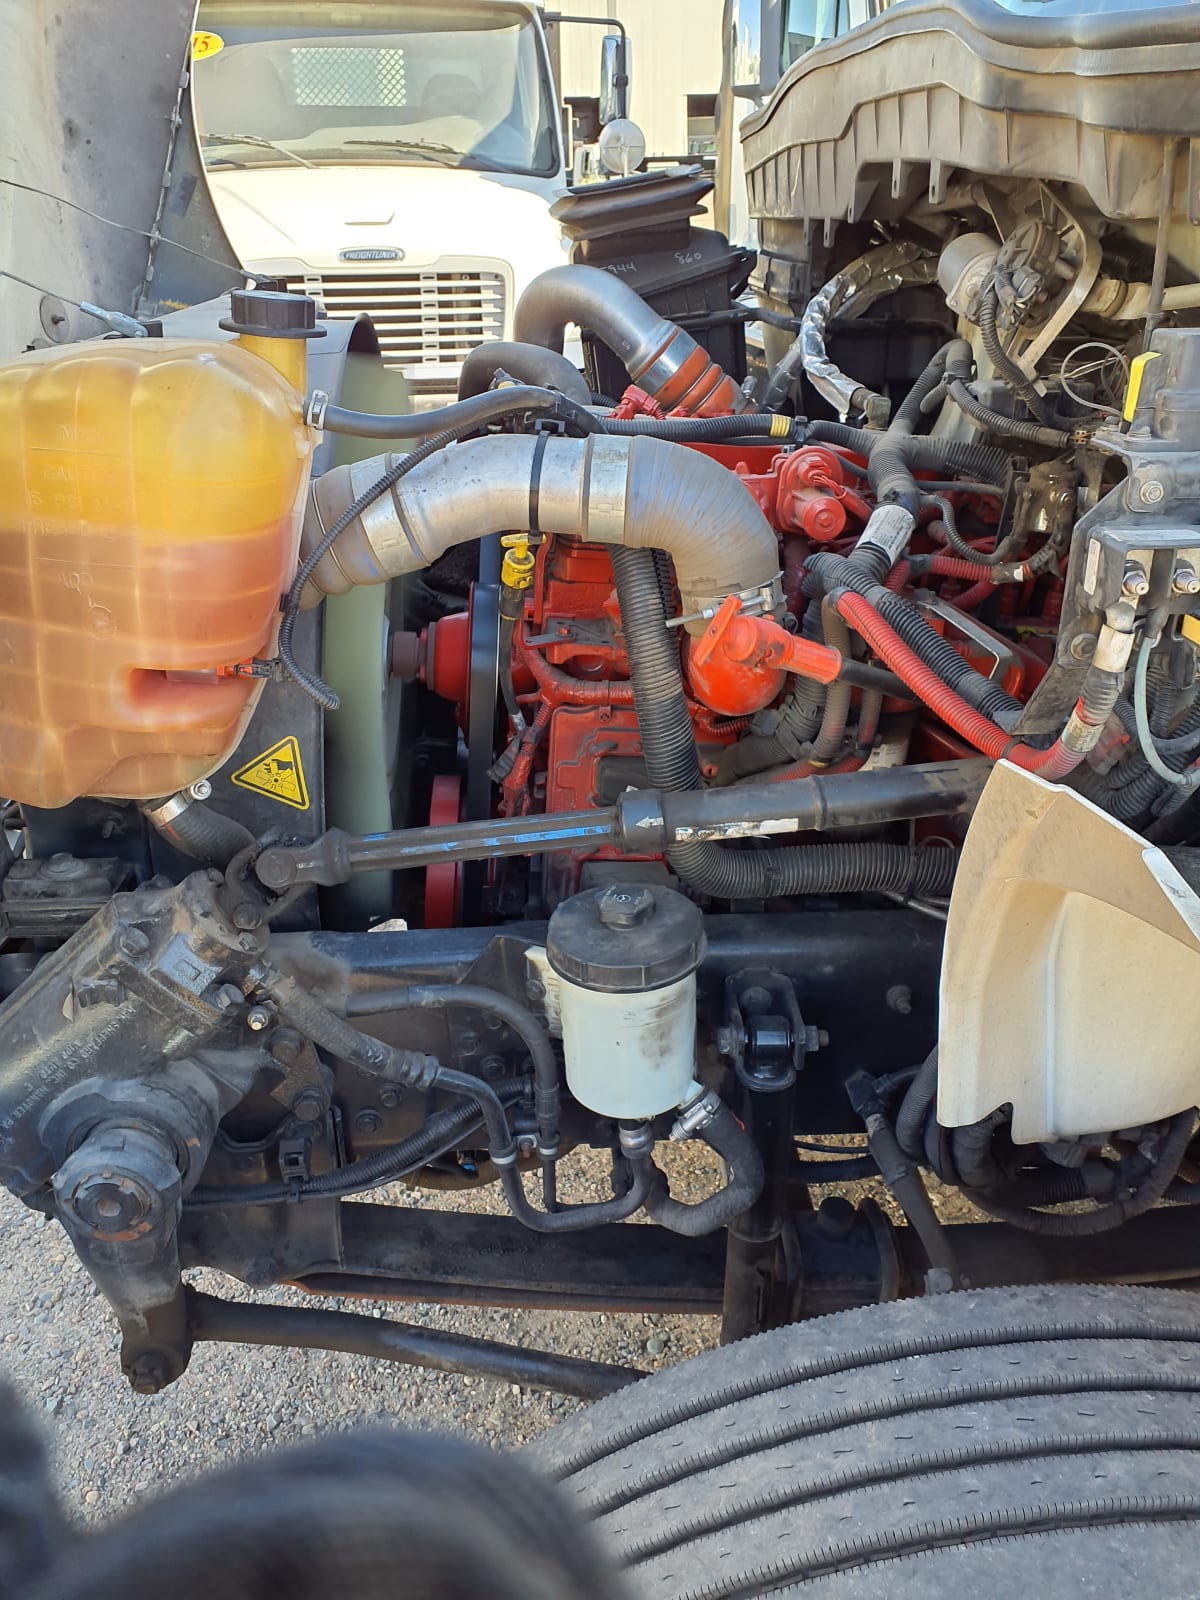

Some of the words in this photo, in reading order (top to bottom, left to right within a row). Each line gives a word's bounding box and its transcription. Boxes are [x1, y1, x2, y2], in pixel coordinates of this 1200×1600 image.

[345, 250, 396, 259] FREIGHTLINER
[674, 252, 702, 264] 860
[13, 1085, 49, 1119] HANOVER
